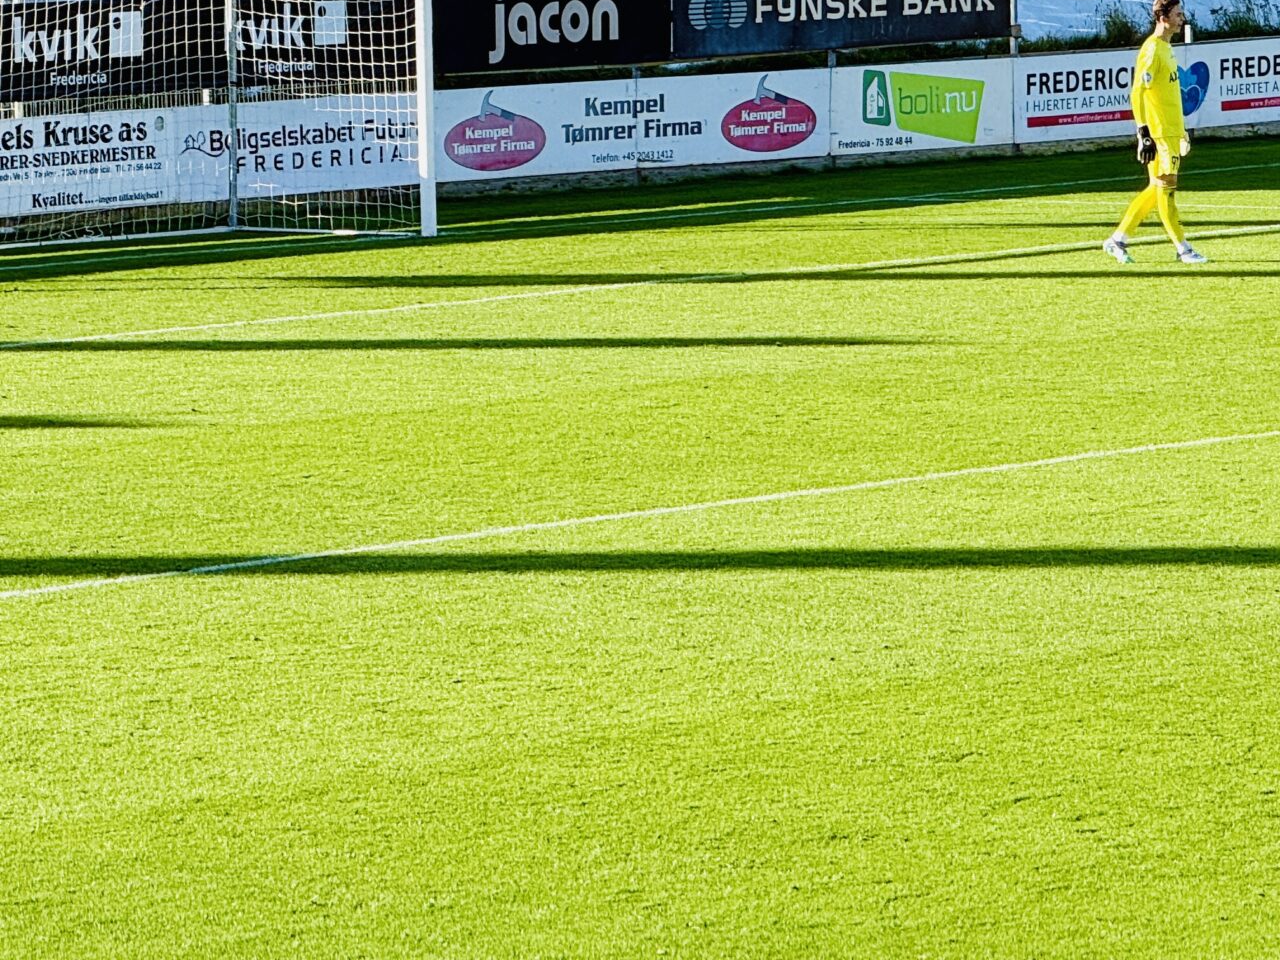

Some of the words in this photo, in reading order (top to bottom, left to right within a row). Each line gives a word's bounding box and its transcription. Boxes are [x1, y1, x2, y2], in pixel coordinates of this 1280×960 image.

[13, 15, 100, 63] kvik
[50, 71, 107, 87] Fredericia
[1026, 66, 1135, 95] FREDERICI
[1227, 81, 1269, 96] HJERTET
[584, 94, 665, 119] Kempel
[898, 86, 977, 115] boli.nu
[1033, 98, 1078, 112] HJERTET
[1081, 96, 1095, 108] AF
[1098, 94, 1131, 108] DANM
[741, 107, 786, 122] Kempel
[0, 123, 33, 151] els
[43, 121, 113, 147] Kruse
[362, 118, 419, 140] Futur
[465, 126, 513, 140] Kempel
[561, 123, 636, 145] Tømrer
[643, 118, 702, 138] Firma
[729, 124, 771, 137] Tømrer
[773, 121, 806, 134] Firma
[452, 143, 497, 155] Tømrer
[500, 140, 535, 152] Firma
[838, 141, 870, 149] Fredericia
[876, 138, 884, 146] 75
[237, 145, 403, 173] FREDERICIA
[622, 152, 635, 160] +45
[657, 150, 674, 159] 1412
[154, 162, 162, 170] 22
